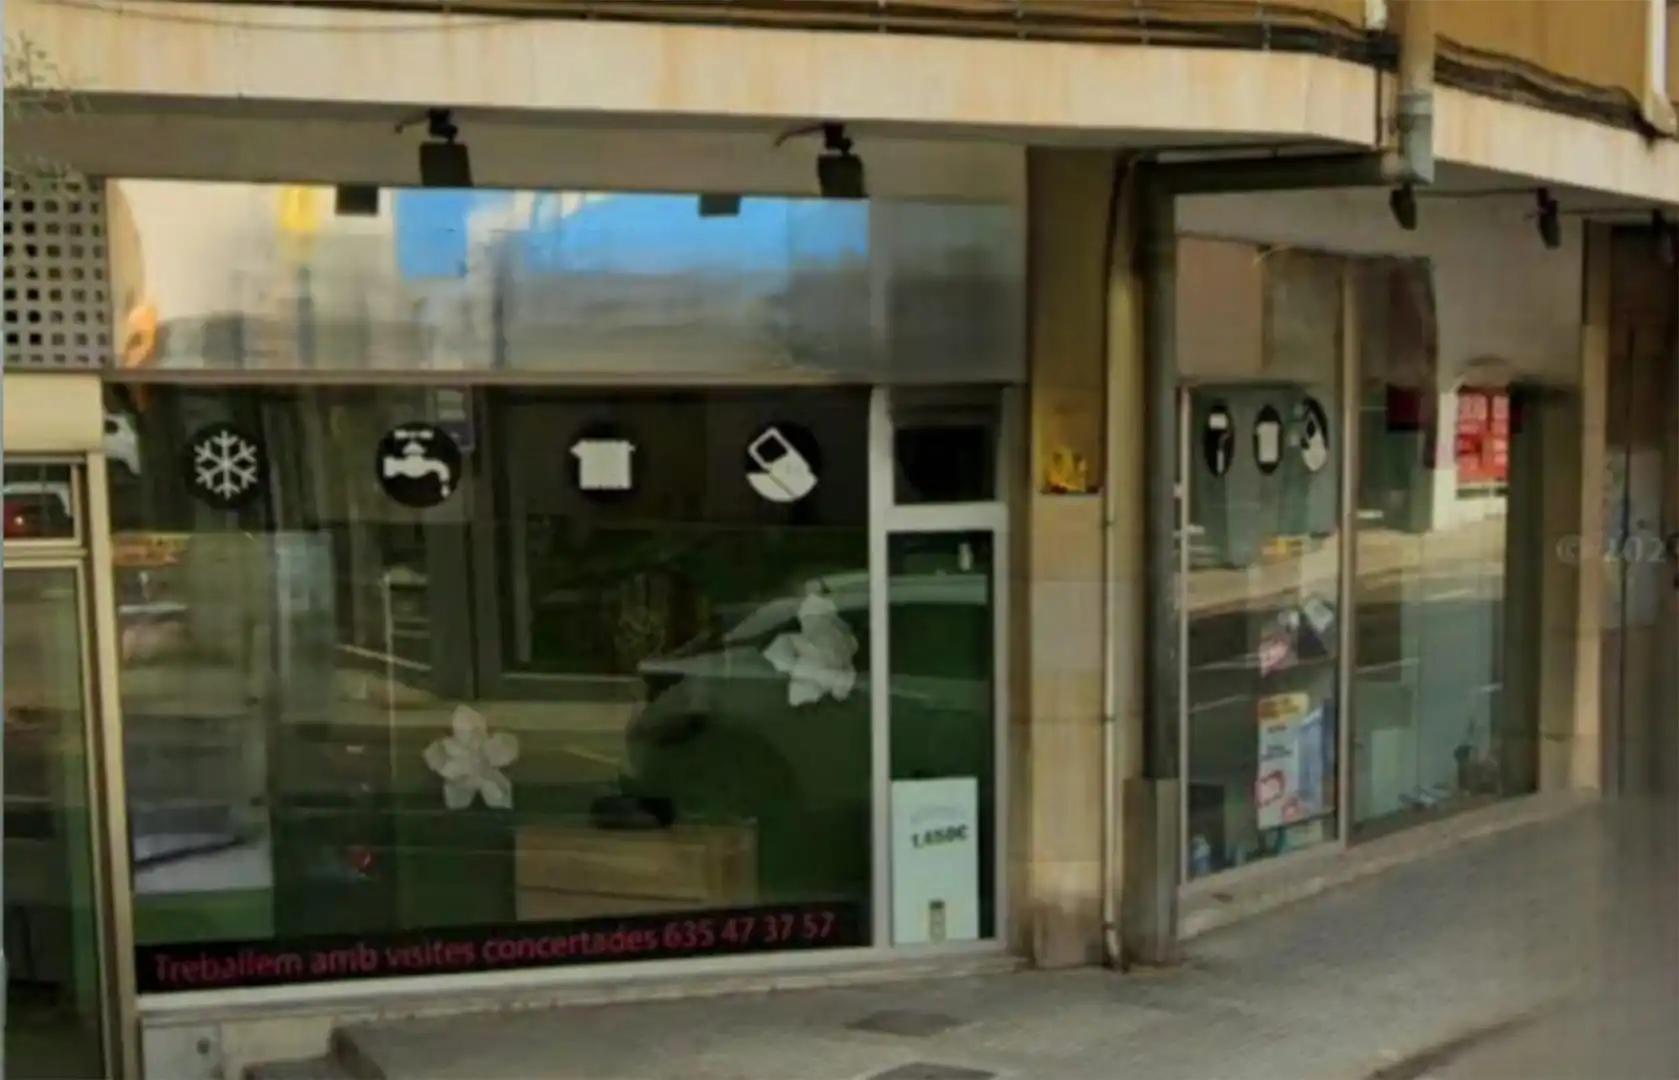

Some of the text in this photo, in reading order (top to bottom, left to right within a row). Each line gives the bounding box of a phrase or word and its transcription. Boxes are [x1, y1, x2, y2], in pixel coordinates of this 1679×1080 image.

[155, 911, 836, 983] Treballem amb visites concertades 635 47 37 57
